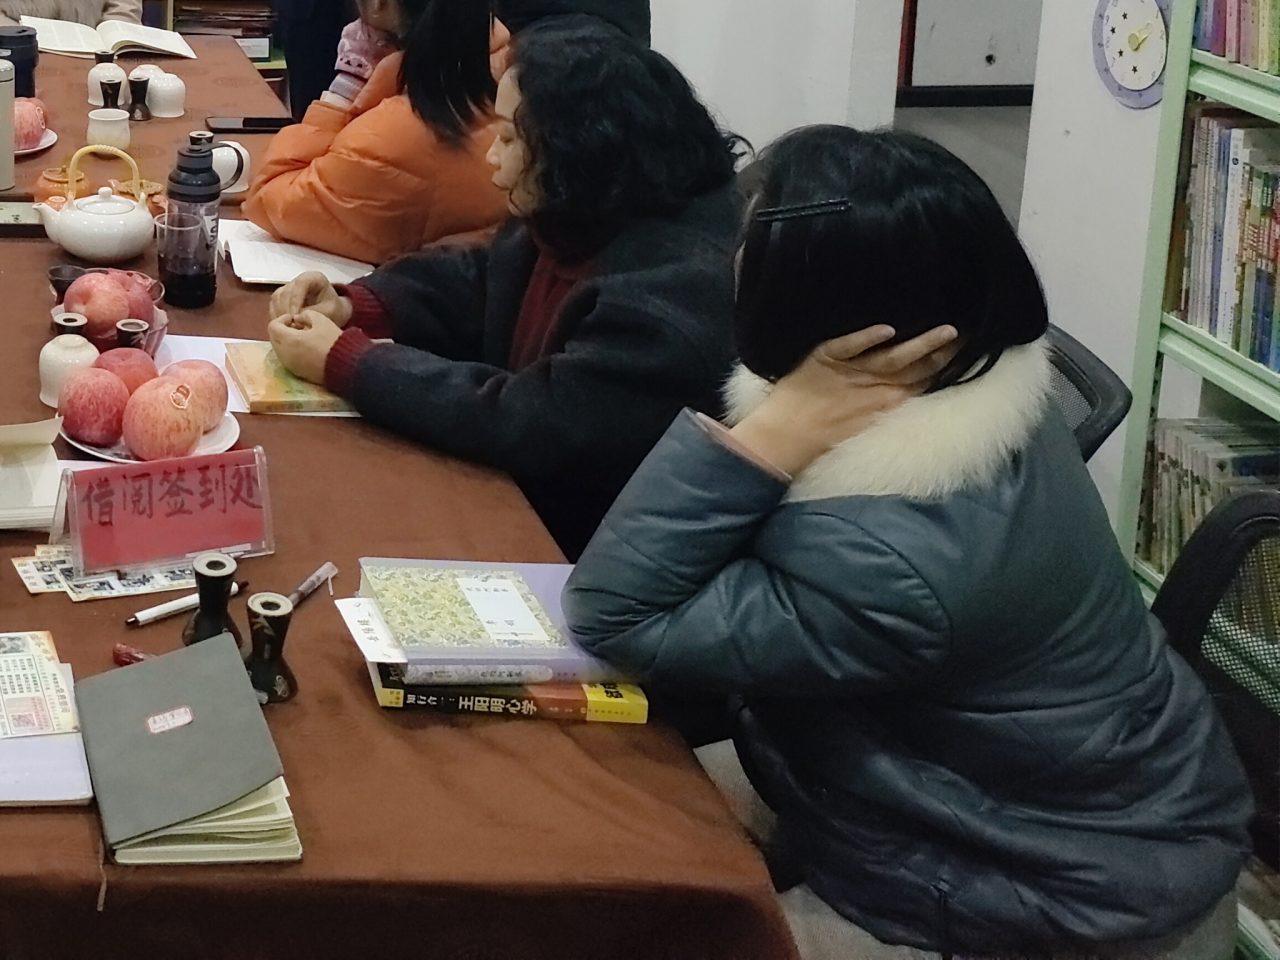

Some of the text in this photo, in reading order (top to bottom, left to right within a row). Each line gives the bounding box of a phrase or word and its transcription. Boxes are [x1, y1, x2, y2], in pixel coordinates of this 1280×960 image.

[82, 463, 265, 527] 借阅签到处
